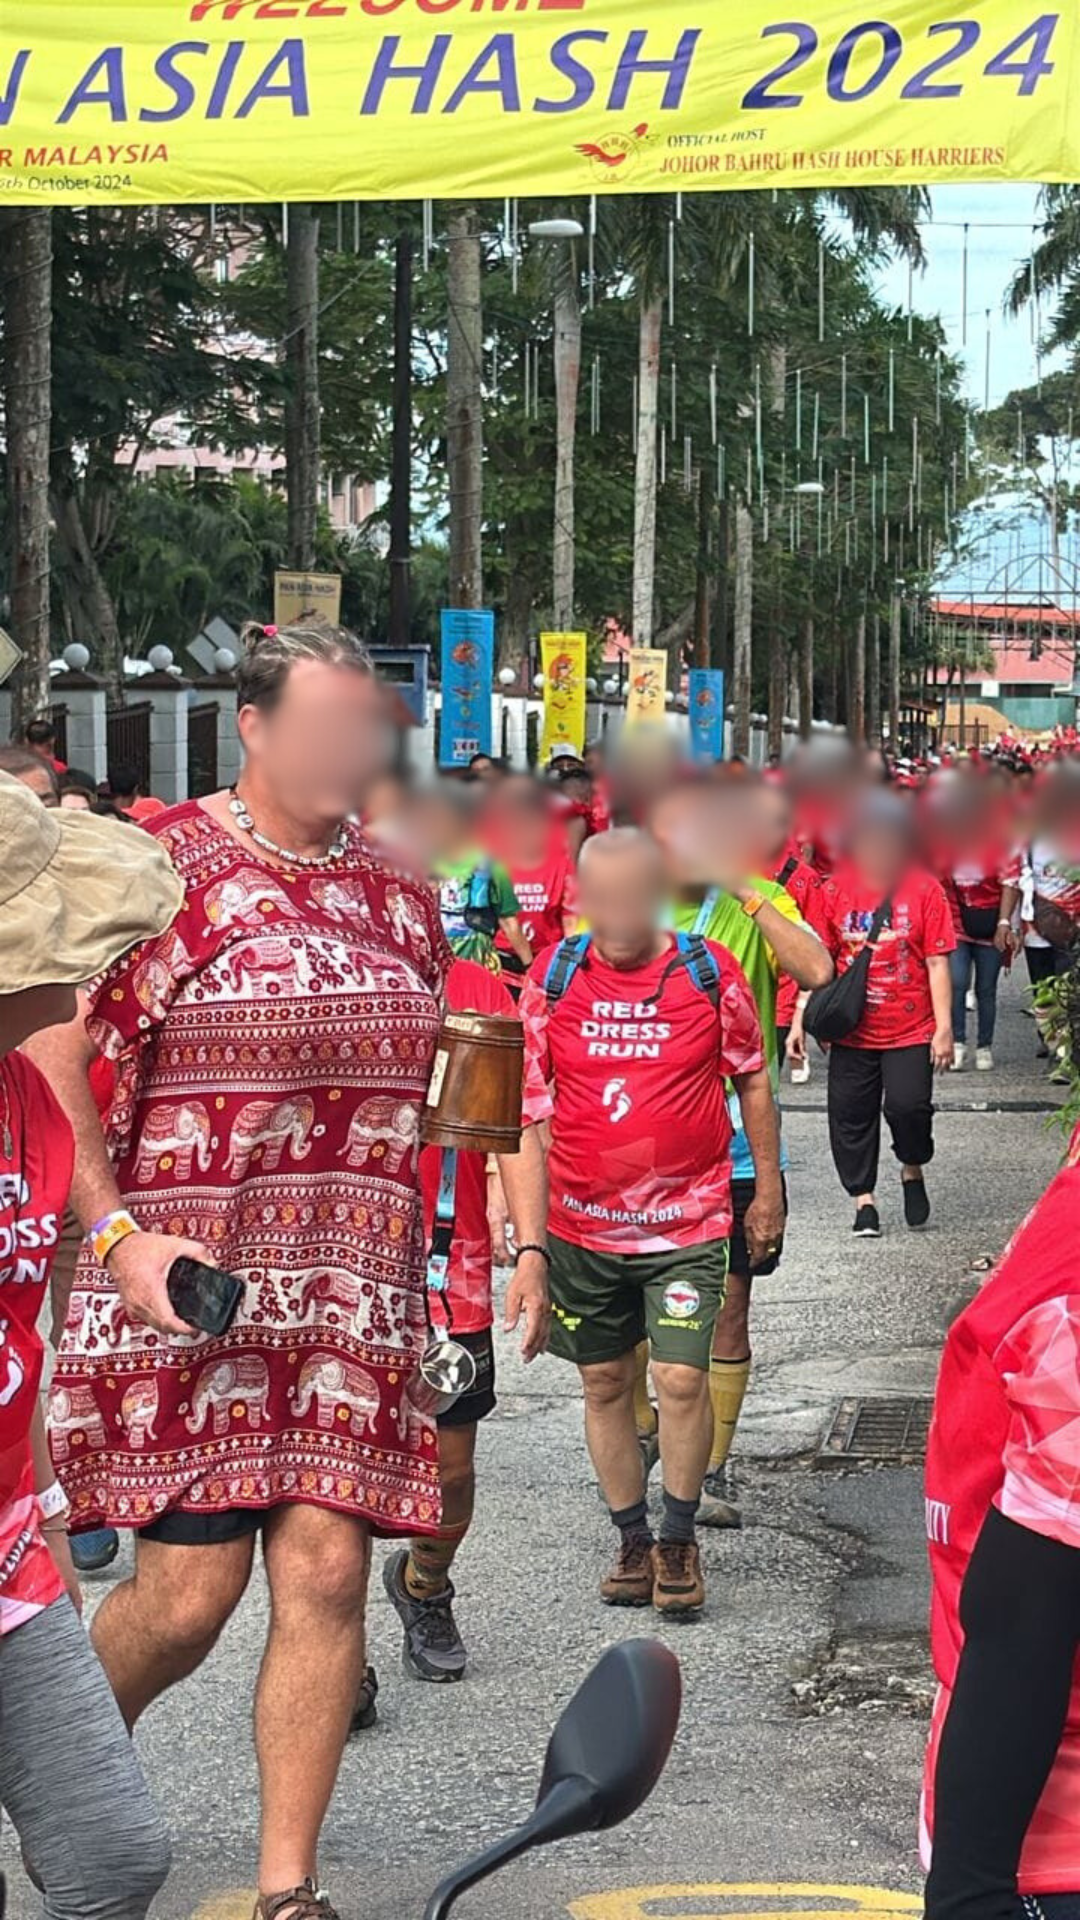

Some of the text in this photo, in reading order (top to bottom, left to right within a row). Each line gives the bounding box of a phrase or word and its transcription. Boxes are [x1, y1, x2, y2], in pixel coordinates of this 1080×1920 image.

[57, 38, 309, 124] ASIA
[360, 28, 702, 116] HASH
[740, 14, 1060, 110] 2024
[667, 128, 767, 148] OFFICIAL HOST
[24, 144, 168, 167] MALAYSIA
[660, 146, 1005, 174] JOHOR BAHRU HASH HOUSE HARRIERS
[28, 174, 90, 190] October
[94, 174, 131, 190] 2024
[521, 903, 546, 912] UN
[592, 1001, 658, 1019] RED
[580, 1020, 672, 1039] DRESS
[588, 1041, 660, 1058] RUN
[584, 1203, 610, 1220] ASIA
[612, 1209, 648, 1224] HASH
[650, 1204, 683, 1223] 2024
